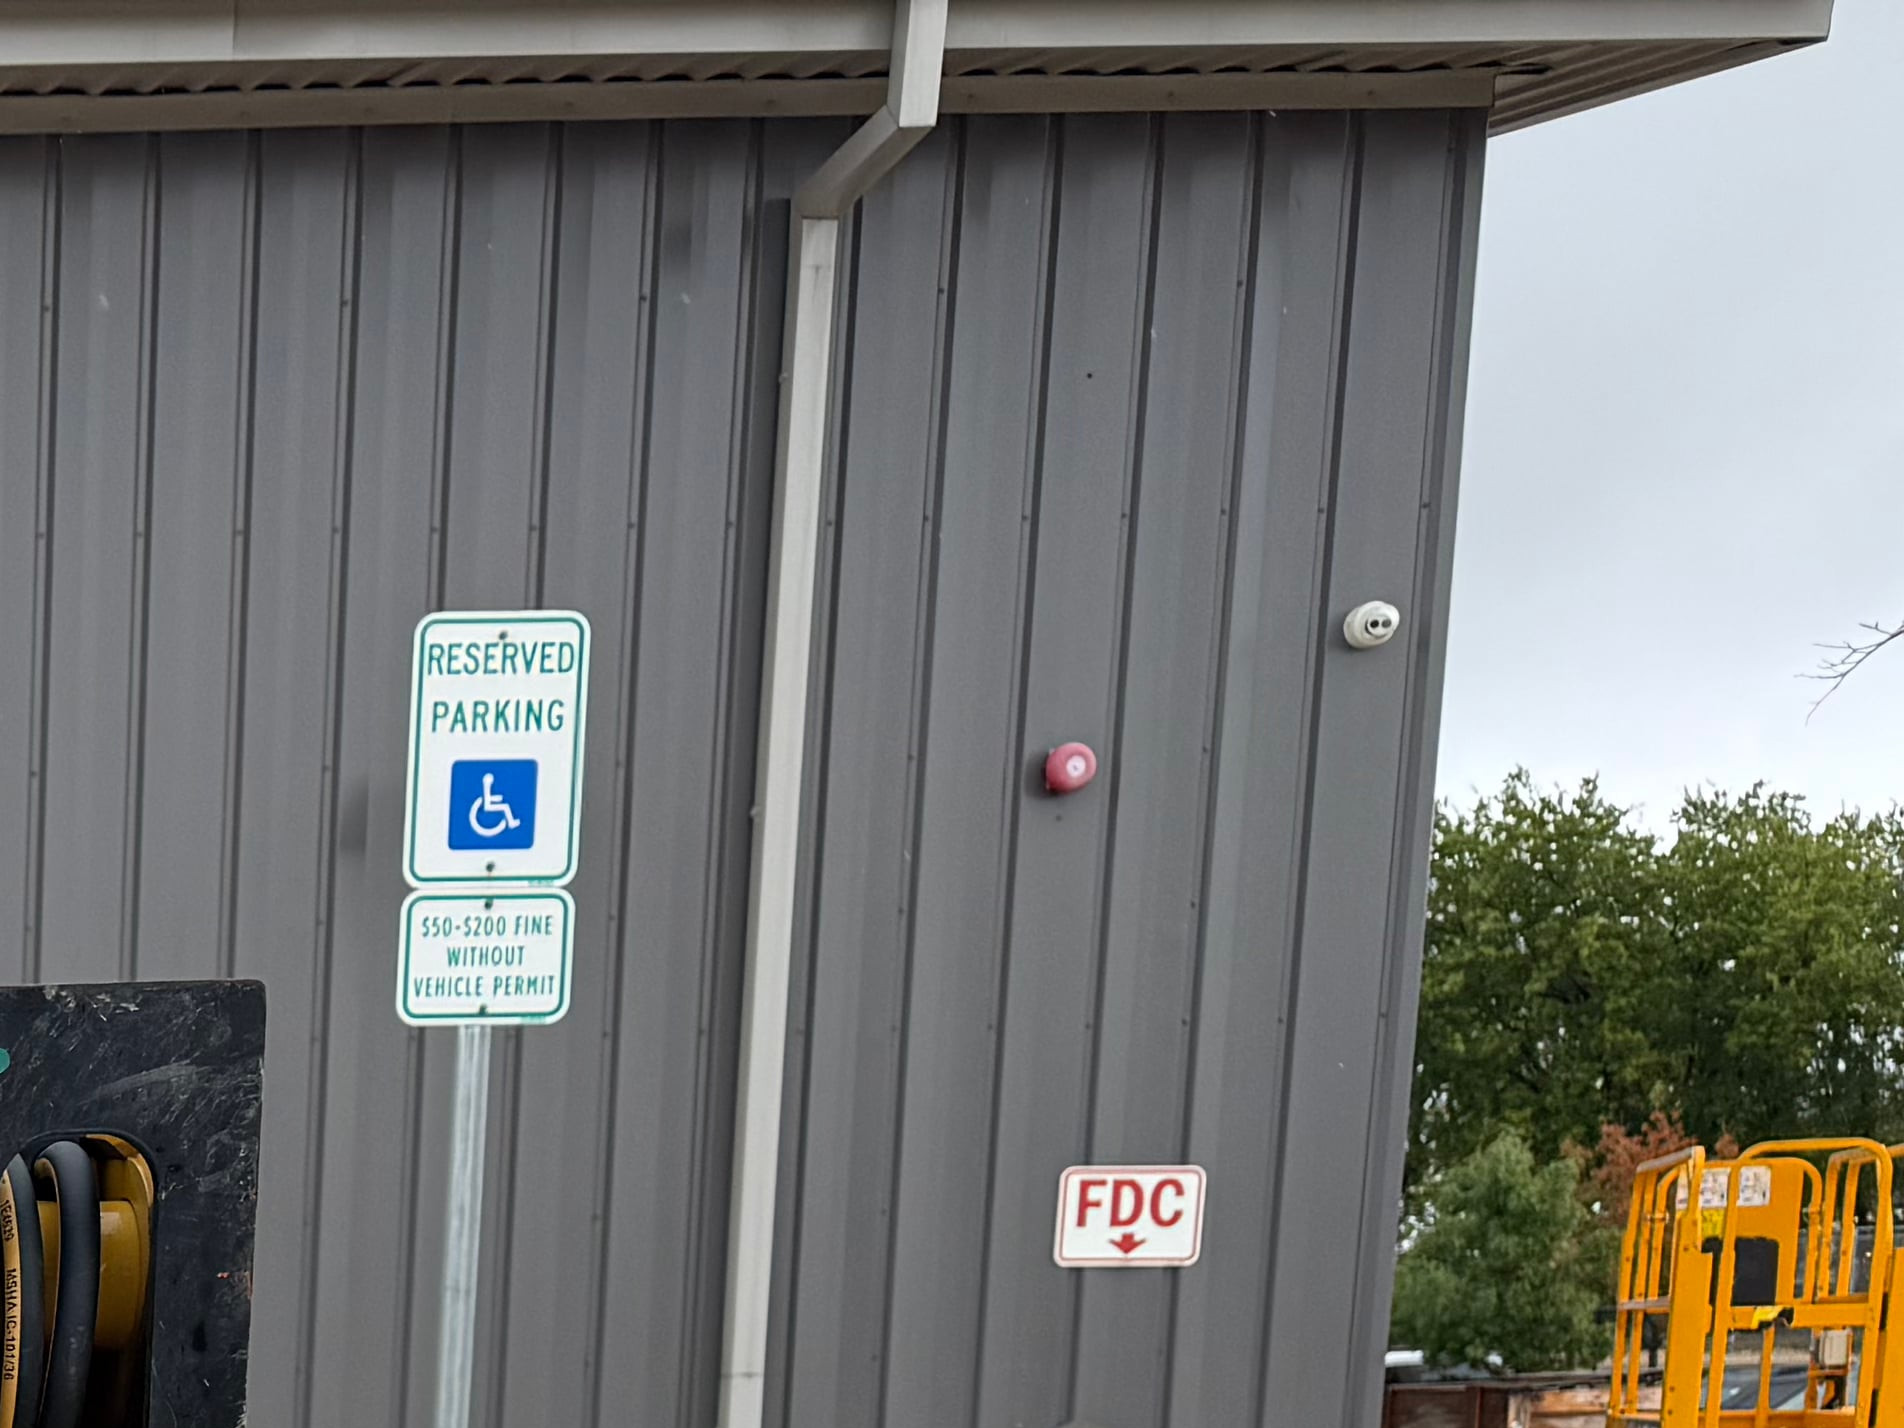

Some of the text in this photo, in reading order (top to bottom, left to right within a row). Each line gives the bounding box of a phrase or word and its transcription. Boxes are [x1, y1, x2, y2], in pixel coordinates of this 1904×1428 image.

[427, 641, 576, 676] RESERVED
[432, 699, 565, 733] PARKING
[421, 914, 554, 938] $50-$200 FINE
[447, 945, 526, 967] WITHOUT
[413, 974, 555, 998] VEHICLE PERMIT
[1076, 1178, 1185, 1228] FDC
